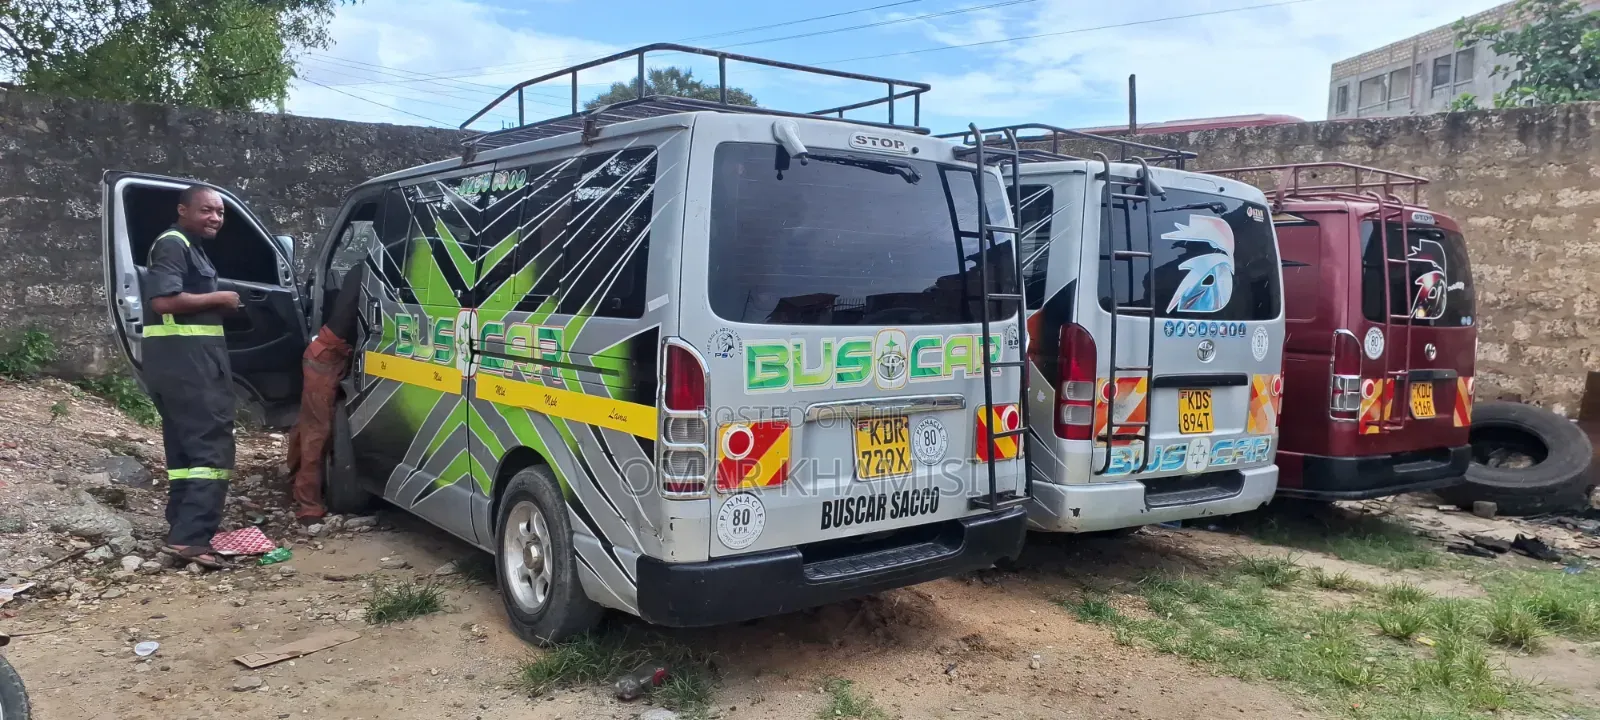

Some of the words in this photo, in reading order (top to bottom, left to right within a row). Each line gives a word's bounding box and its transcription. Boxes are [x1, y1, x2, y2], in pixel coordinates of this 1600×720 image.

[855, 135, 904, 149] STOP
[1187, 391, 1209, 410] KDS
[1183, 412, 1210, 431] 894T
[869, 418, 905, 446] KDR
[924, 430, 936, 446] 80
[861, 447, 909, 475] 729X
[720, 496, 763, 521] PINNACLE
[733, 508, 750, 526] 80
[821, 493, 887, 530] BUSCAR
[890, 486, 940, 519] SACCO
